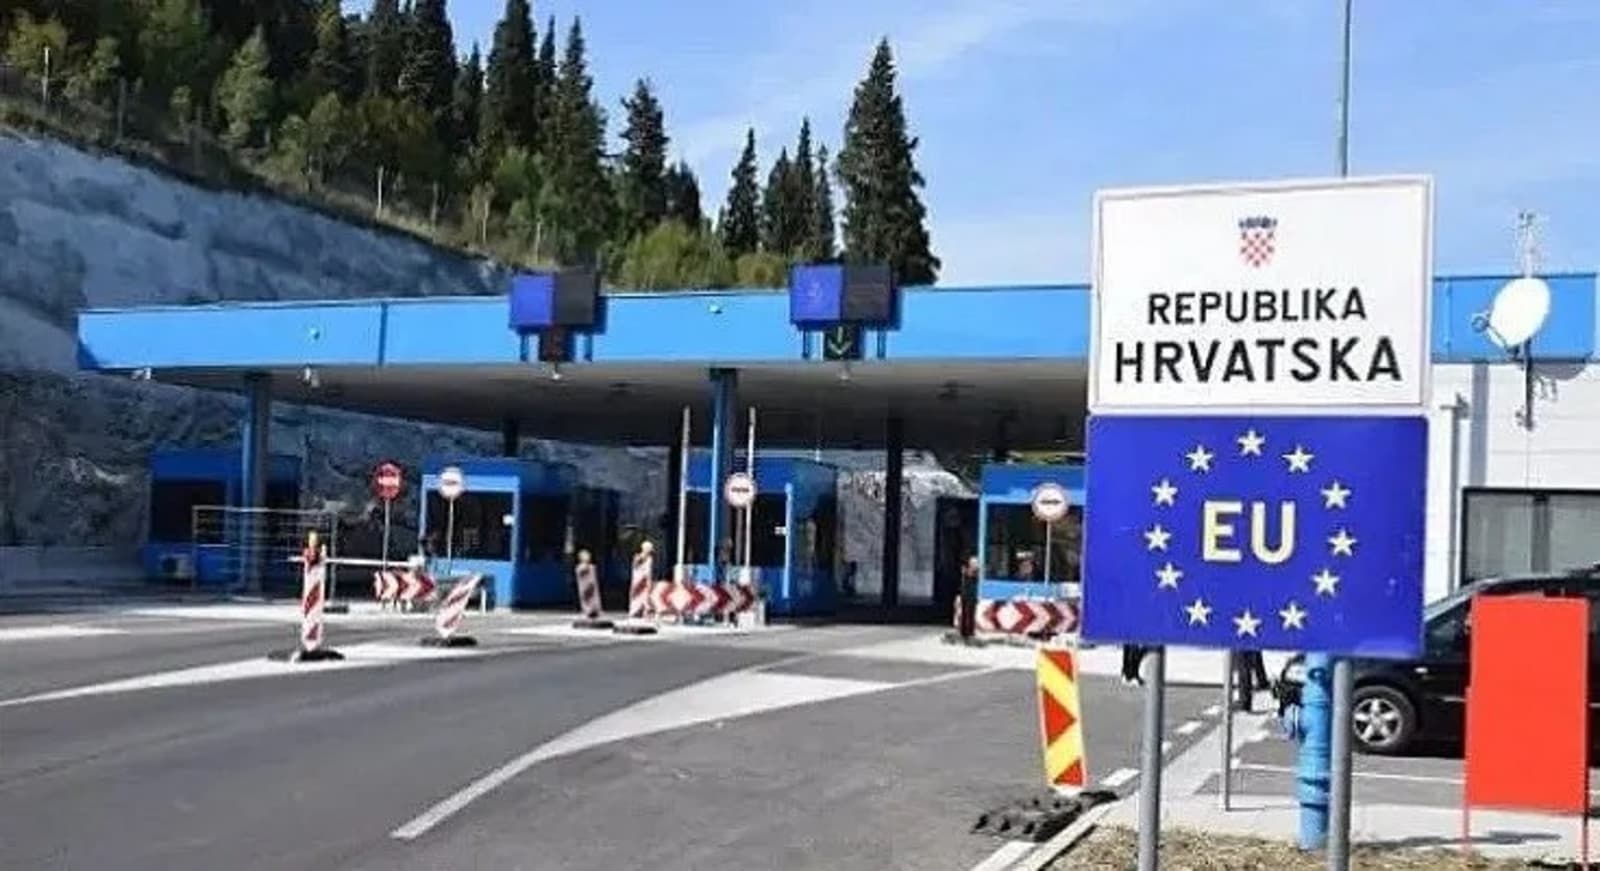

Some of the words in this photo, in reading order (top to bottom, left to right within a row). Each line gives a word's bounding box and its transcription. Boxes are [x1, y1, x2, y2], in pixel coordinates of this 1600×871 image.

[1148, 287, 1366, 325] REPUBLIKA
[1114, 337, 1401, 383] HRVATSKA
[1202, 501, 1296, 564] EU
